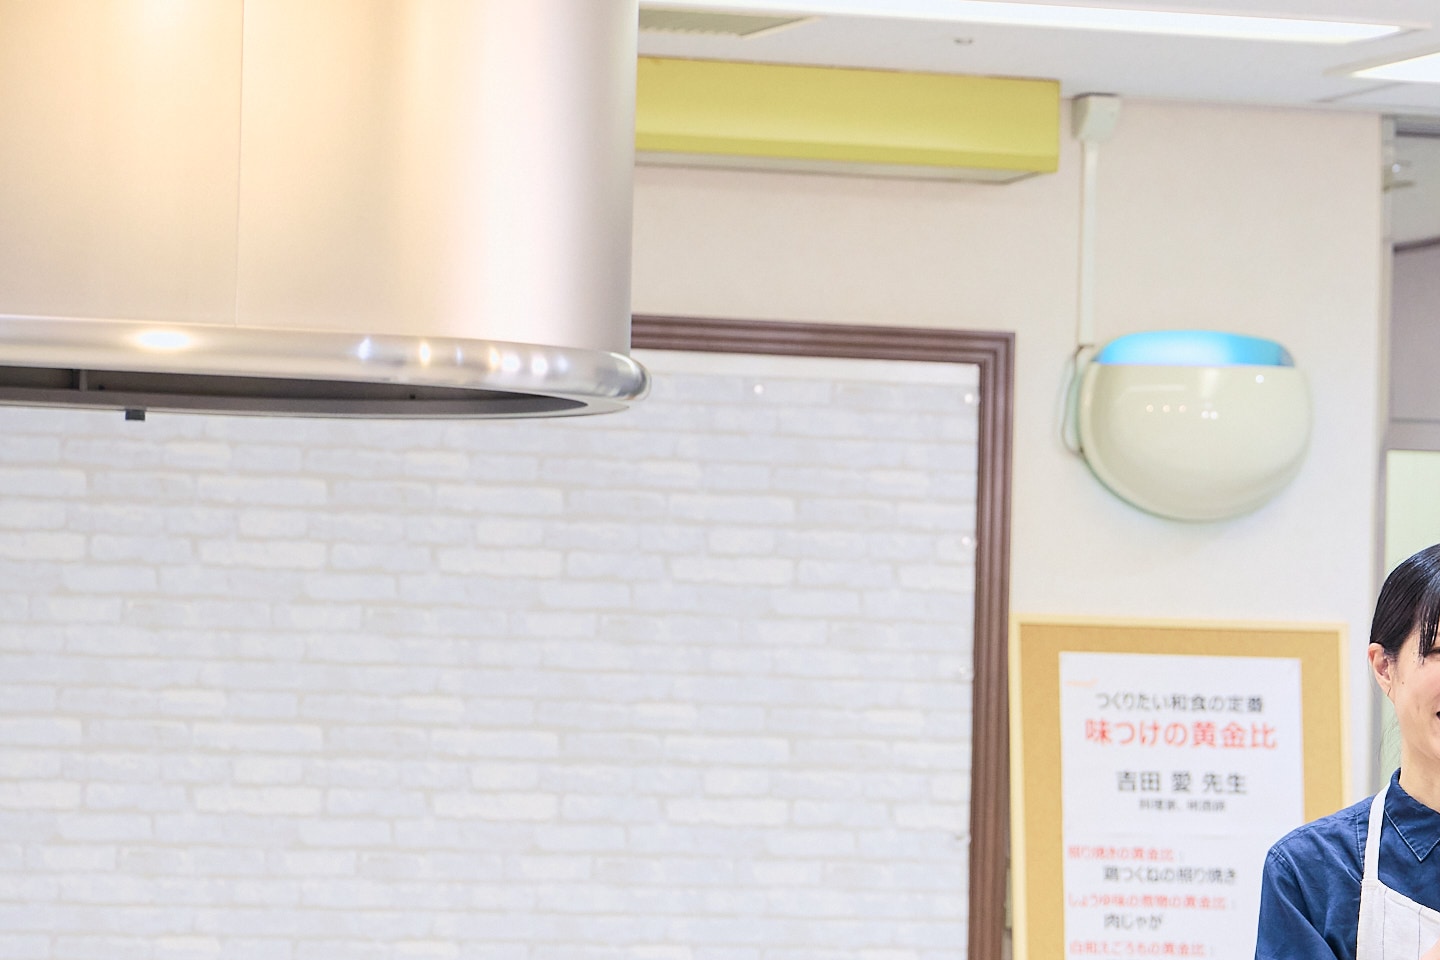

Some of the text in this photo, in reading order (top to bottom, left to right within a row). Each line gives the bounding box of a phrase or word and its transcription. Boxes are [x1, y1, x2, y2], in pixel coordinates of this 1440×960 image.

[1096, 693, 1264, 713] つくりたい和食の定番
[1085, 718, 1277, 749] 味つけの黄金比
[1117, 771, 1247, 795] 吉田 愛 先生
[1104, 914, 1163, 931] 肉じゃが
